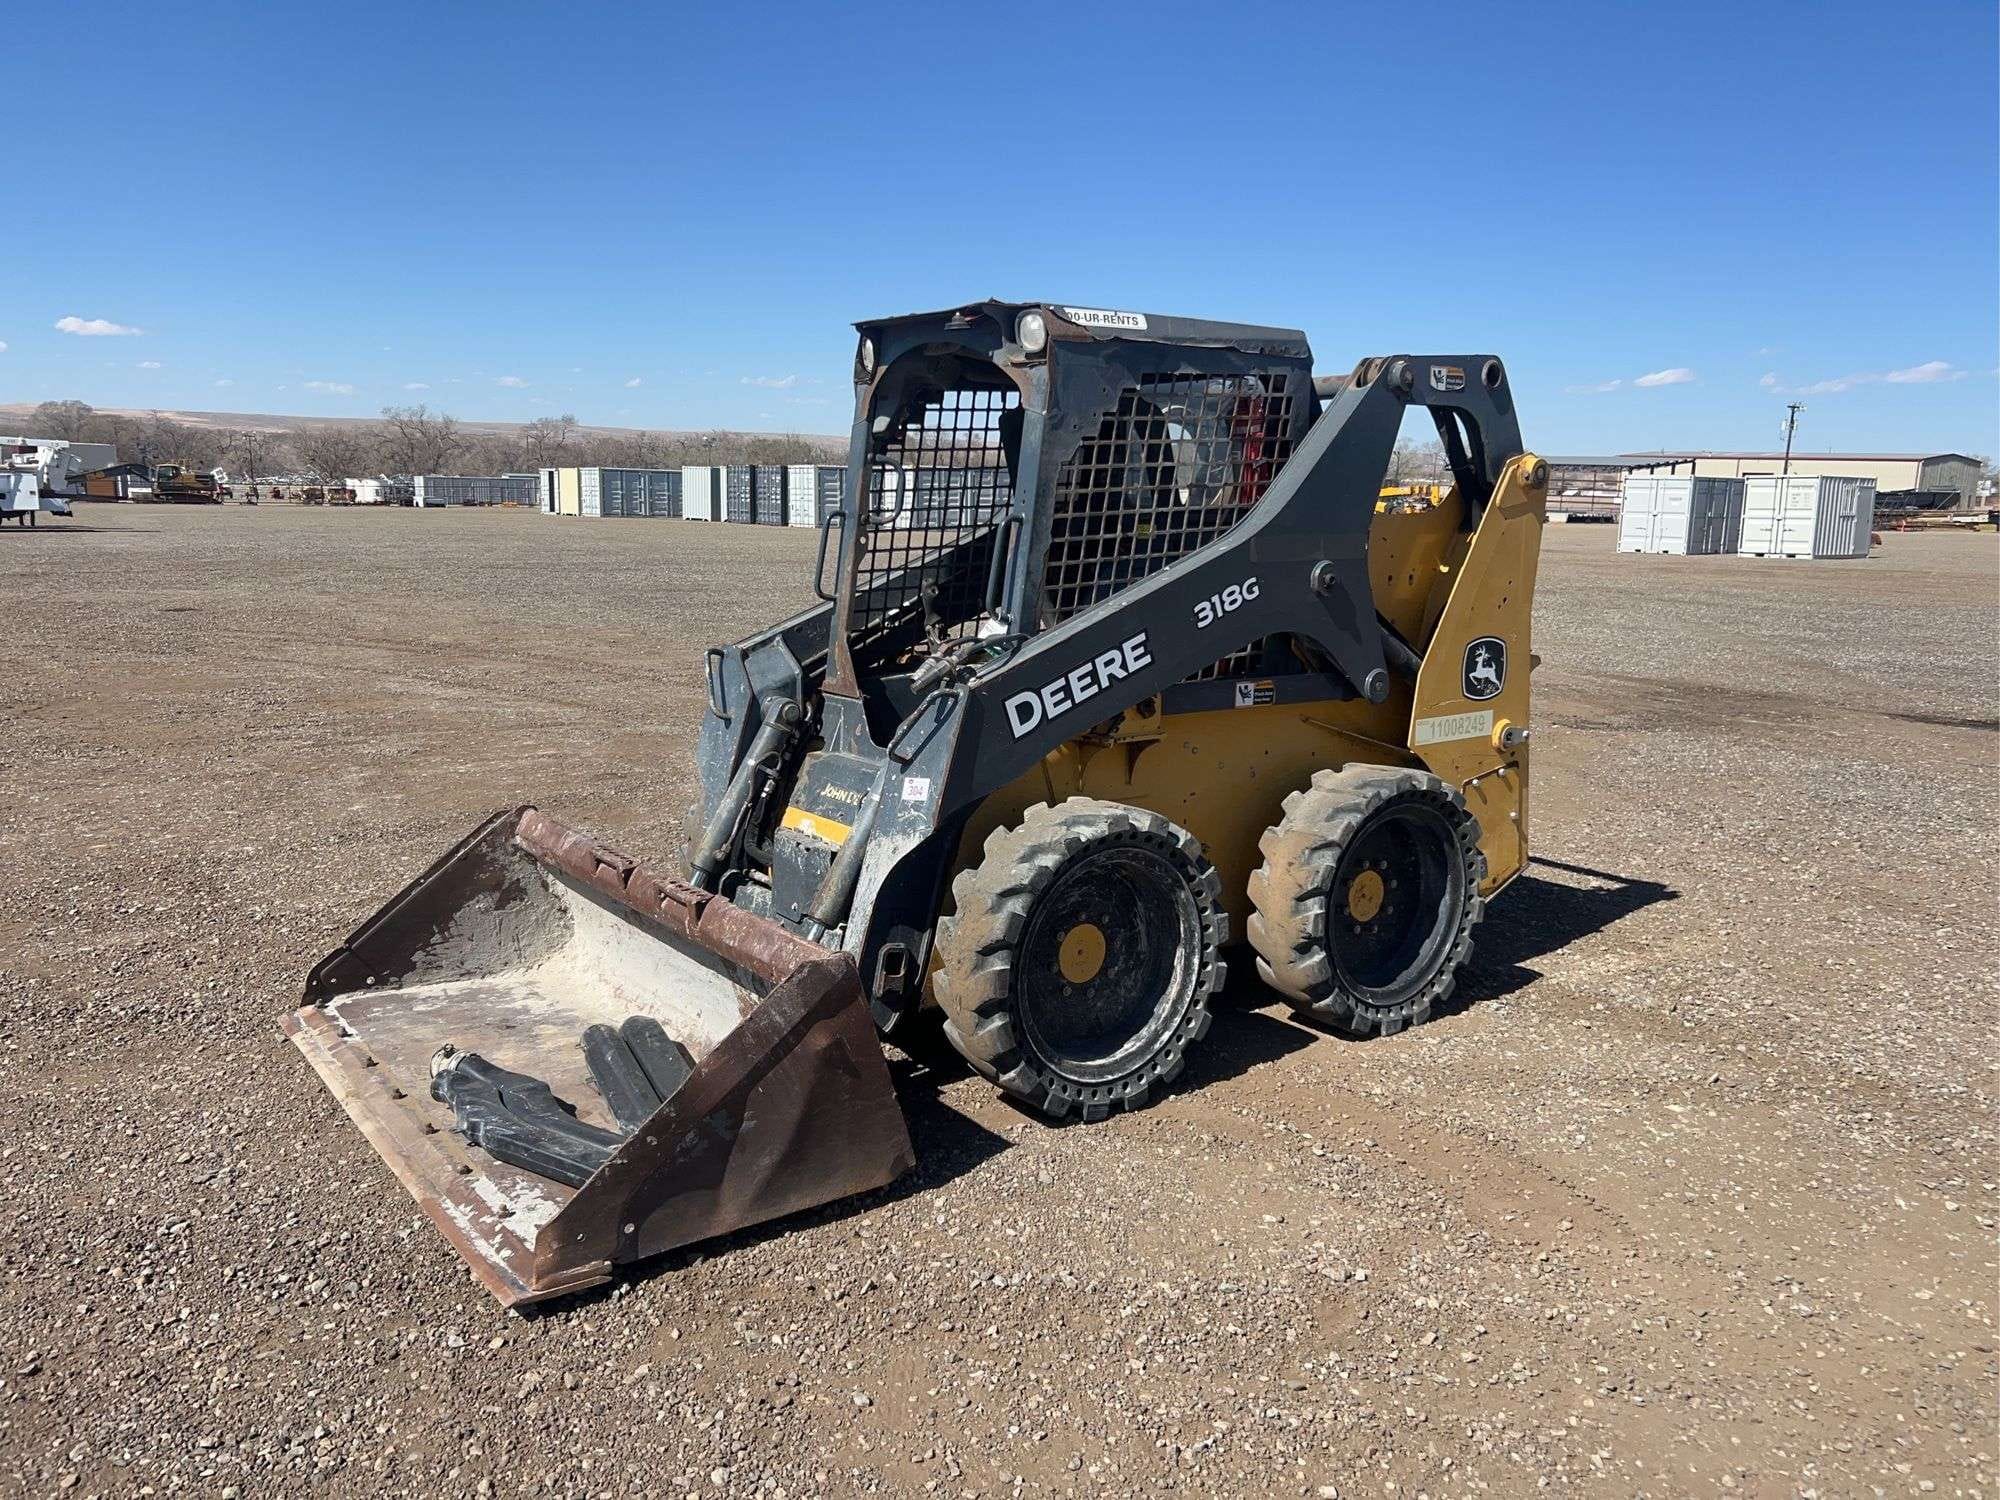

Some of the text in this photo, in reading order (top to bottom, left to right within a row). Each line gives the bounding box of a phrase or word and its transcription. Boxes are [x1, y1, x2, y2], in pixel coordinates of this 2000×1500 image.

[1193, 576, 1260, 629] 318G
[1004, 632, 1152, 739] DEERE
[1430, 714, 1486, 739] 11008249
[820, 783, 848, 802] JOHN
